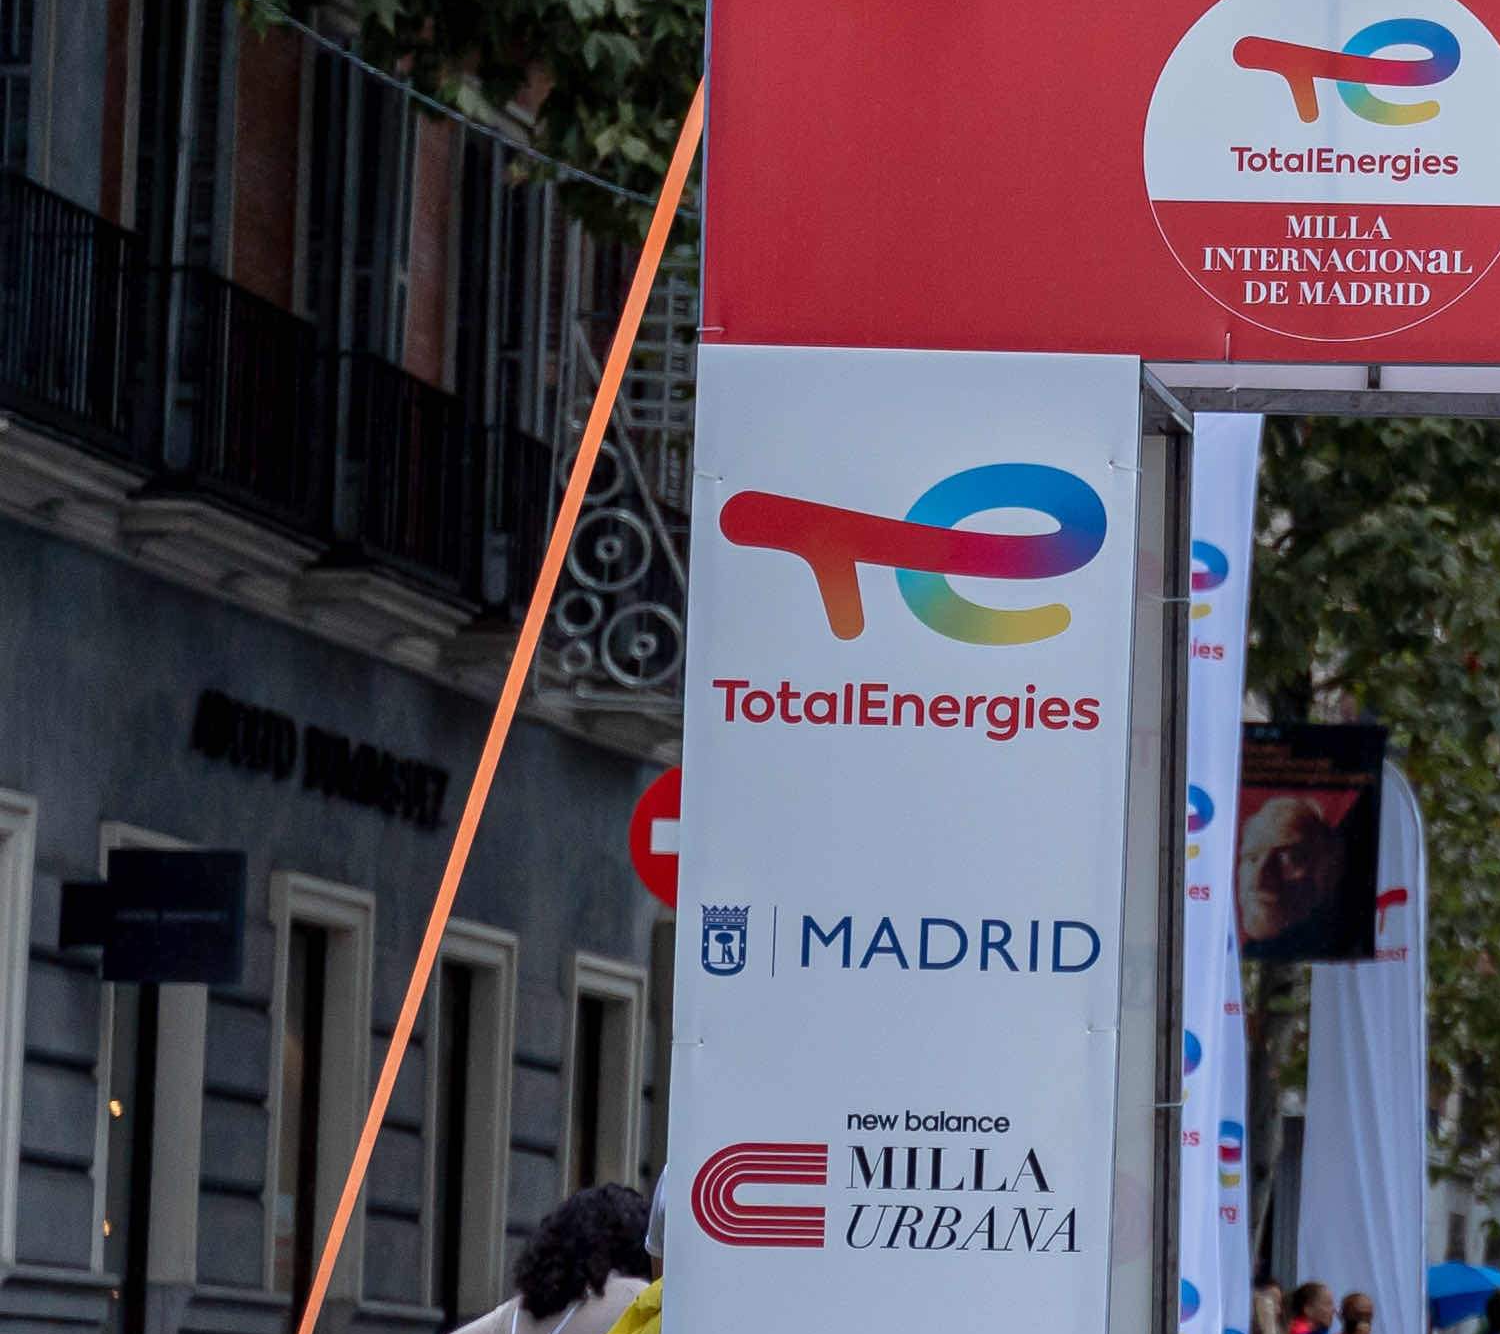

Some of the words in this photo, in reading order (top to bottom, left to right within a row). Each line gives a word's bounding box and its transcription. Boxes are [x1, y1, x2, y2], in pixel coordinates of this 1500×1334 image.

[1231, 146, 1459, 182] TotalEnergies
[1286, 215, 1392, 240] MILLA
[1244, 279, 1288, 305] DE
[1298, 280, 1431, 307] MADRID
[713, 679, 1101, 742] TotalEnergies
[800, 914, 1102, 974] MADRID
[846, 1112, 899, 1132] new
[904, 1109, 1010, 1134] balance
[846, 1145, 1055, 1194] MILLA
[846, 1204, 1081, 1253] URBANA
